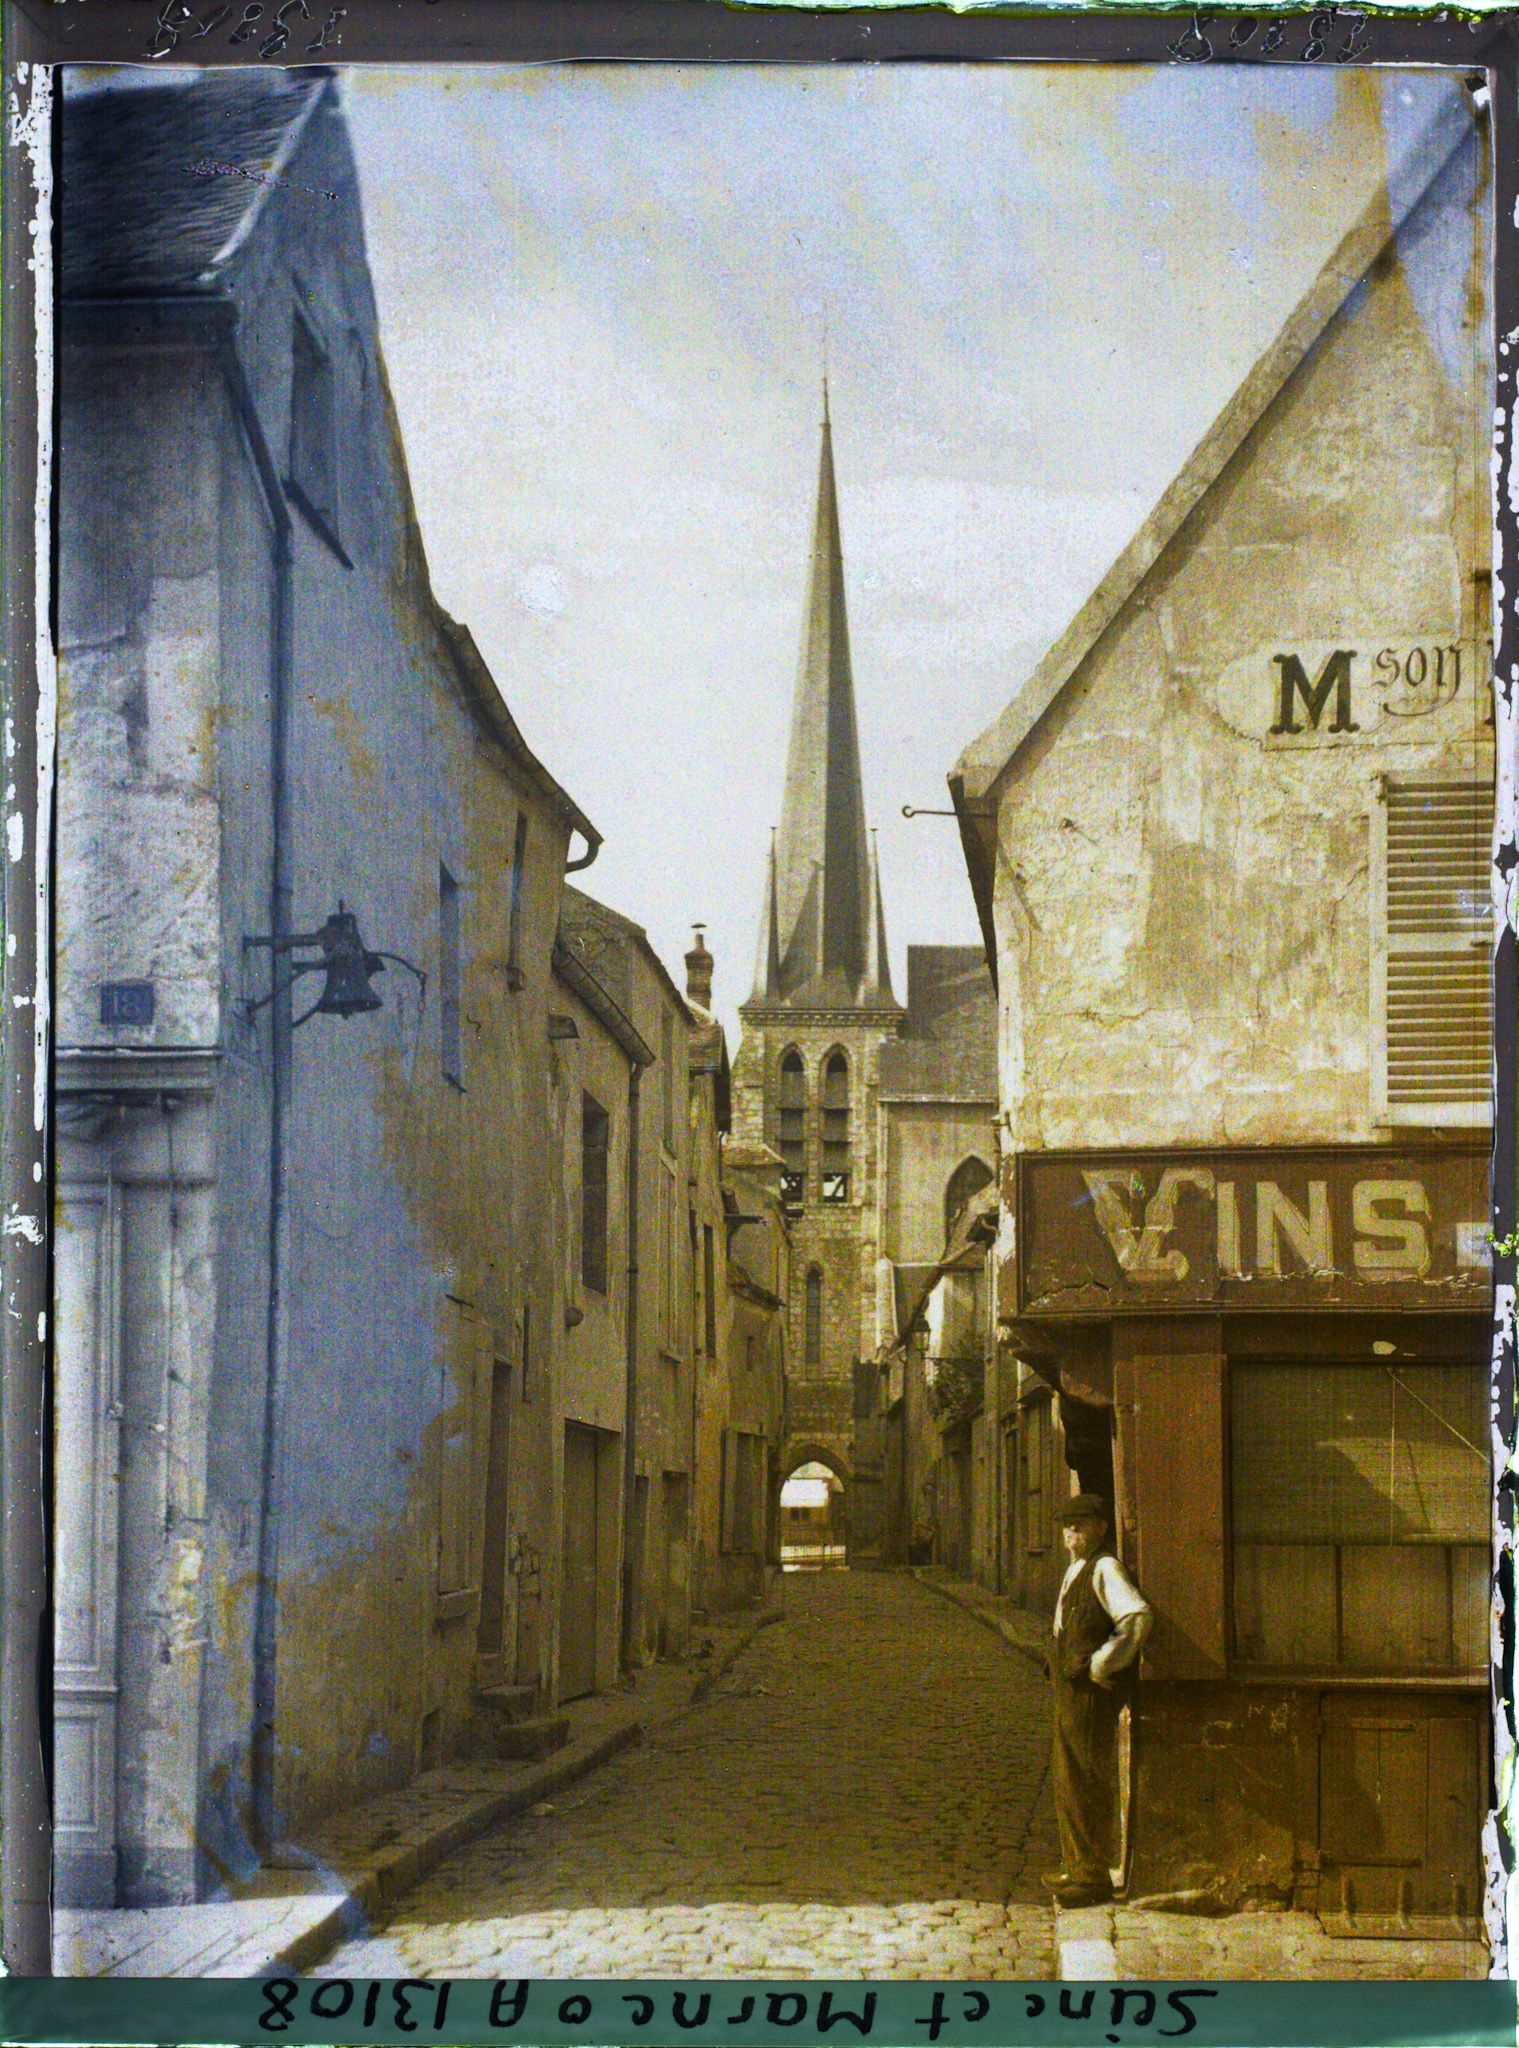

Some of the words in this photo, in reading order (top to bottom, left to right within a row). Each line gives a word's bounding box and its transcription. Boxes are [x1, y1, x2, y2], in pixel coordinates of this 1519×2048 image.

[1080, 1166, 1432, 1281] VINS
[257, 1978, 450, 2033] 13108
[621, 1990, 879, 2036] Marne
[914, 1989, 991, 2037] et
[1025, 1987, 1220, 2044] Seine
